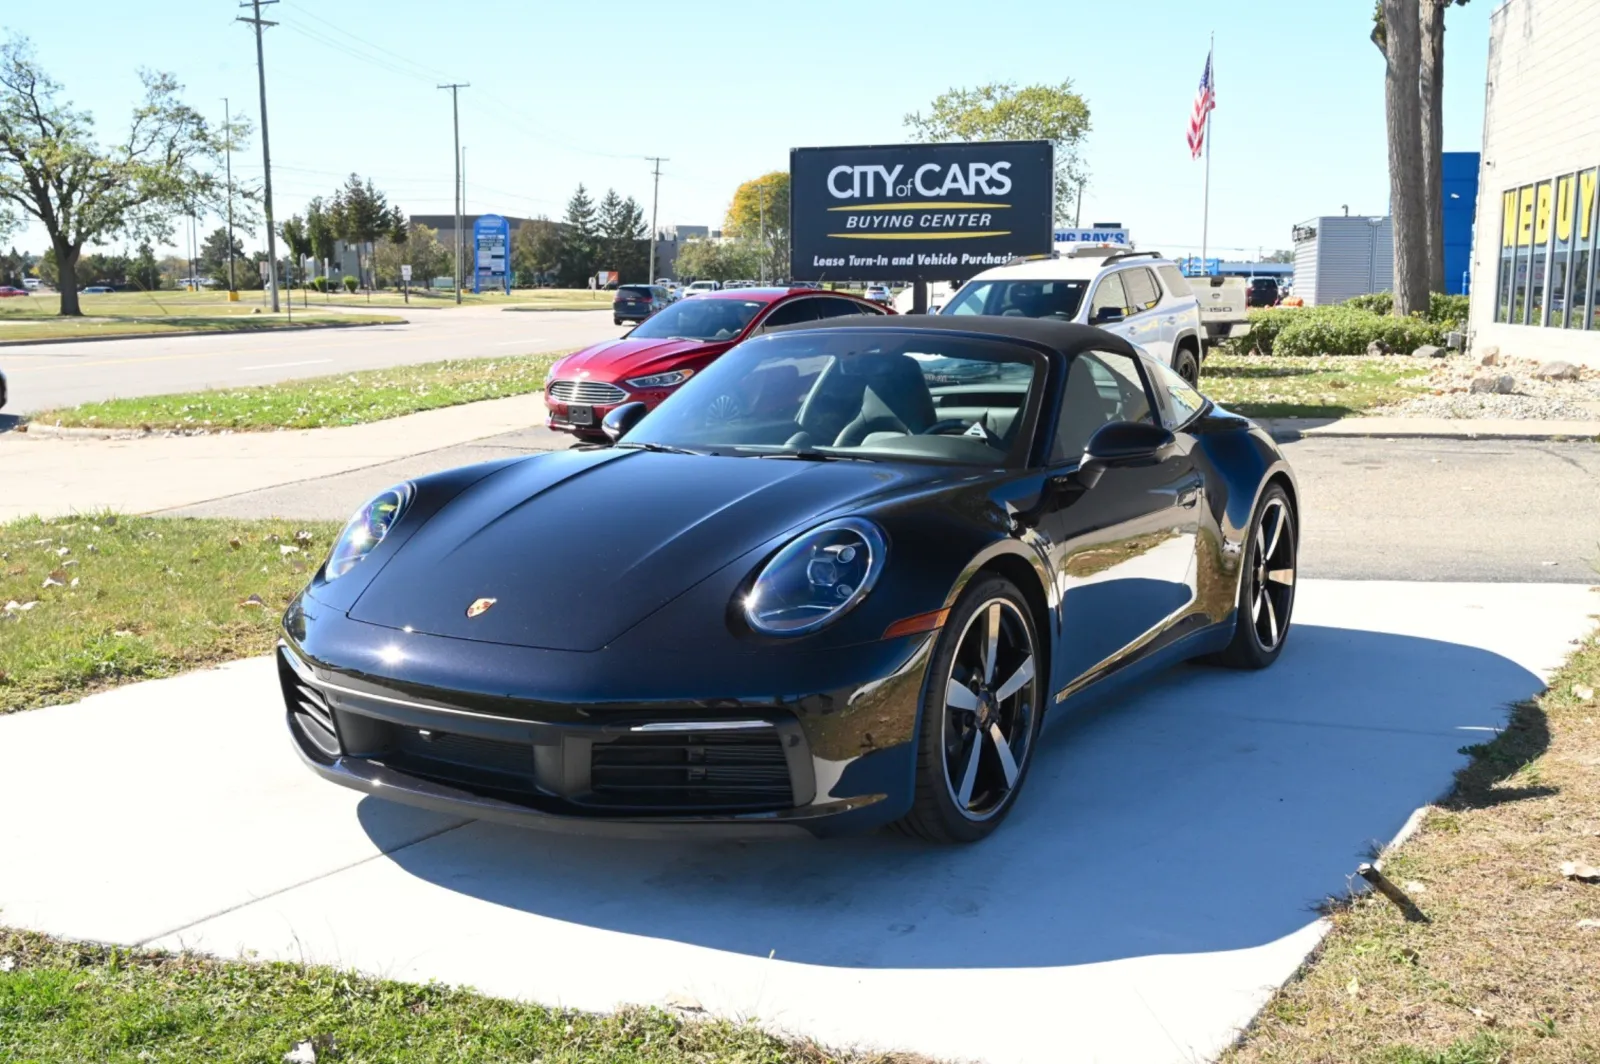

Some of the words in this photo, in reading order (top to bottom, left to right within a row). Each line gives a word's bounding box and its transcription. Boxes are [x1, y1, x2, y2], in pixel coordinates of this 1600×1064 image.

[827, 164, 904, 199] CITY
[896, 178, 913, 197] of
[914, 161, 1012, 197] CARS
[846, 215, 914, 229] BUYING
[919, 213, 991, 228] CENTER
[813, 255, 845, 267] Lease
[849, 255, 888, 266] Turn-In
[891, 254, 914, 266] and
[917, 253, 958, 266] Vehicle
